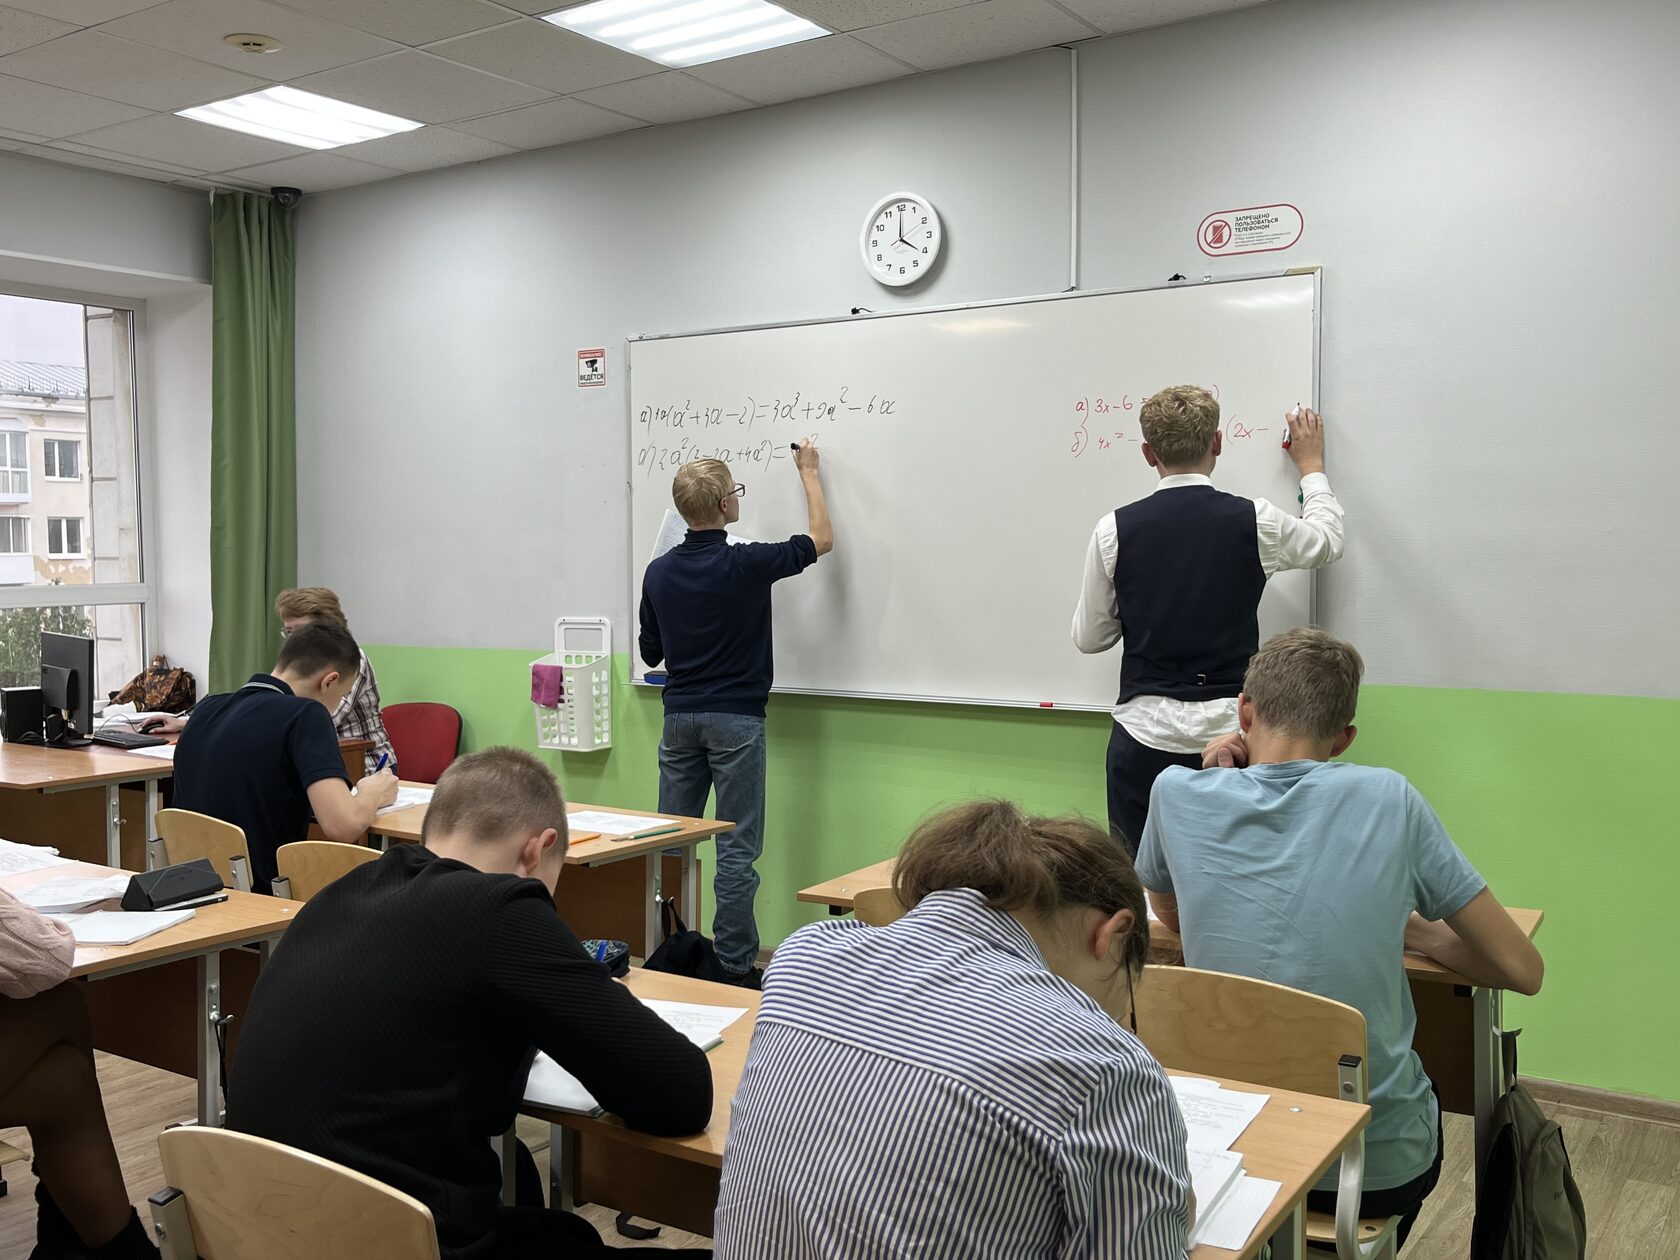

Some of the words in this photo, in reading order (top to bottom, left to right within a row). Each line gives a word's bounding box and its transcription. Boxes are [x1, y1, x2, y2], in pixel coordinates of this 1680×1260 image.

[896, 204, 906, 212] 12
[912, 206, 917, 214] 1
[884, 211, 893, 219] 11
[1235, 212, 1270, 222] ЗАПРЕЩЕНО
[921, 216, 928, 224] 2
[1234, 217, 1279, 227] ПОЛЬЗОВАТЬСЯ
[875, 224, 885, 232] 10
[1234, 224, 1270, 233] ТЕЛЕФОНОМ
[926, 231, 932, 239] 3
[922, 246, 928, 254] 4
